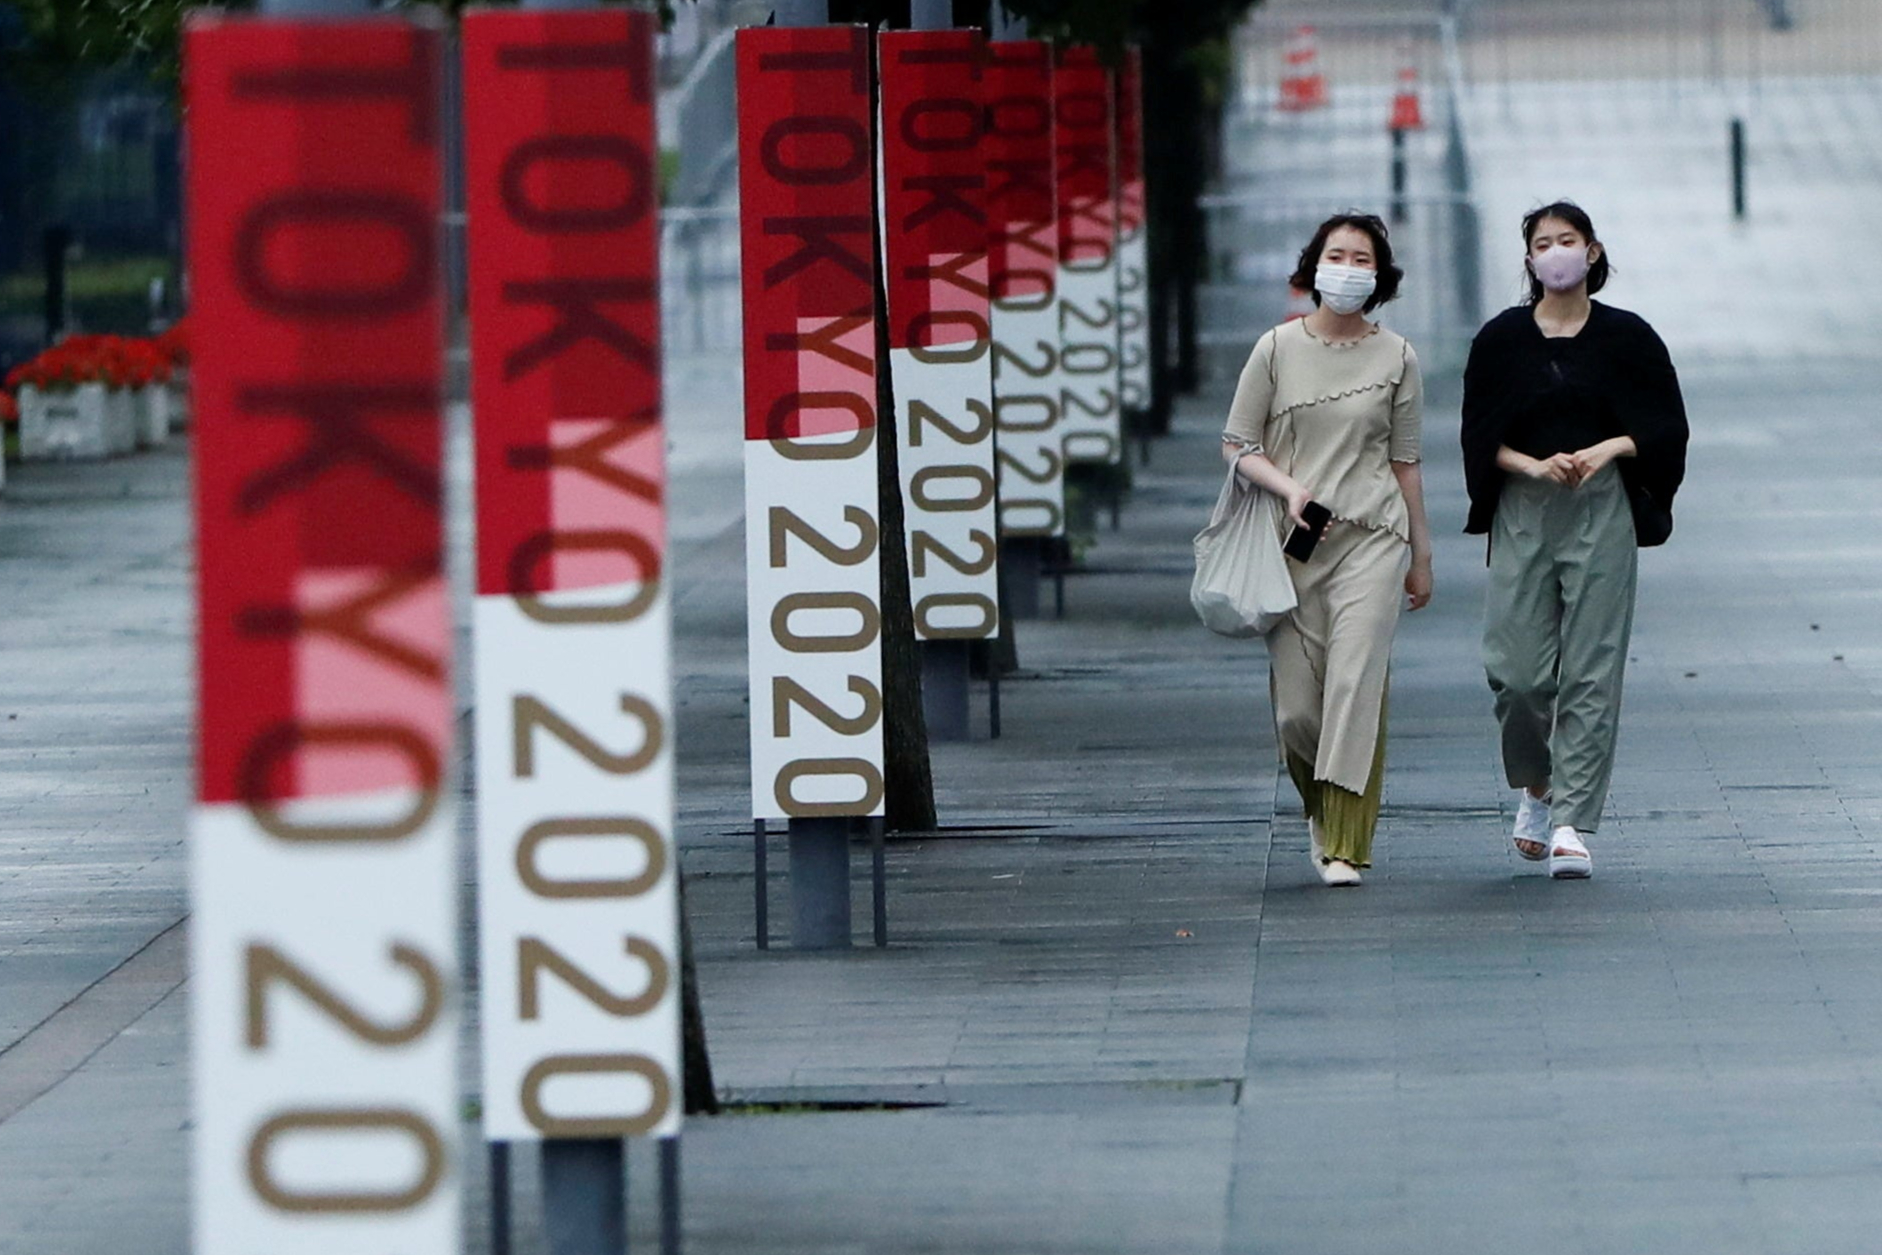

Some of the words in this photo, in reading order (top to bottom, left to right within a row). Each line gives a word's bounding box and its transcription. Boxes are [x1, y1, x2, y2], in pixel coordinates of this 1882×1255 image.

[496, 12, 662, 625] TOKYO
[759, 28, 874, 461] TOKYO
[901, 33, 991, 364] TOKYO
[988, 41, 1055, 311] TOKYO
[230, 27, 446, 843] TOKYO
[908, 398, 997, 640] 2020
[993, 340, 1060, 537] 2020
[1059, 297, 1116, 461] 2020
[768, 505, 884, 819] 2020
[511, 694, 672, 1138] 2020
